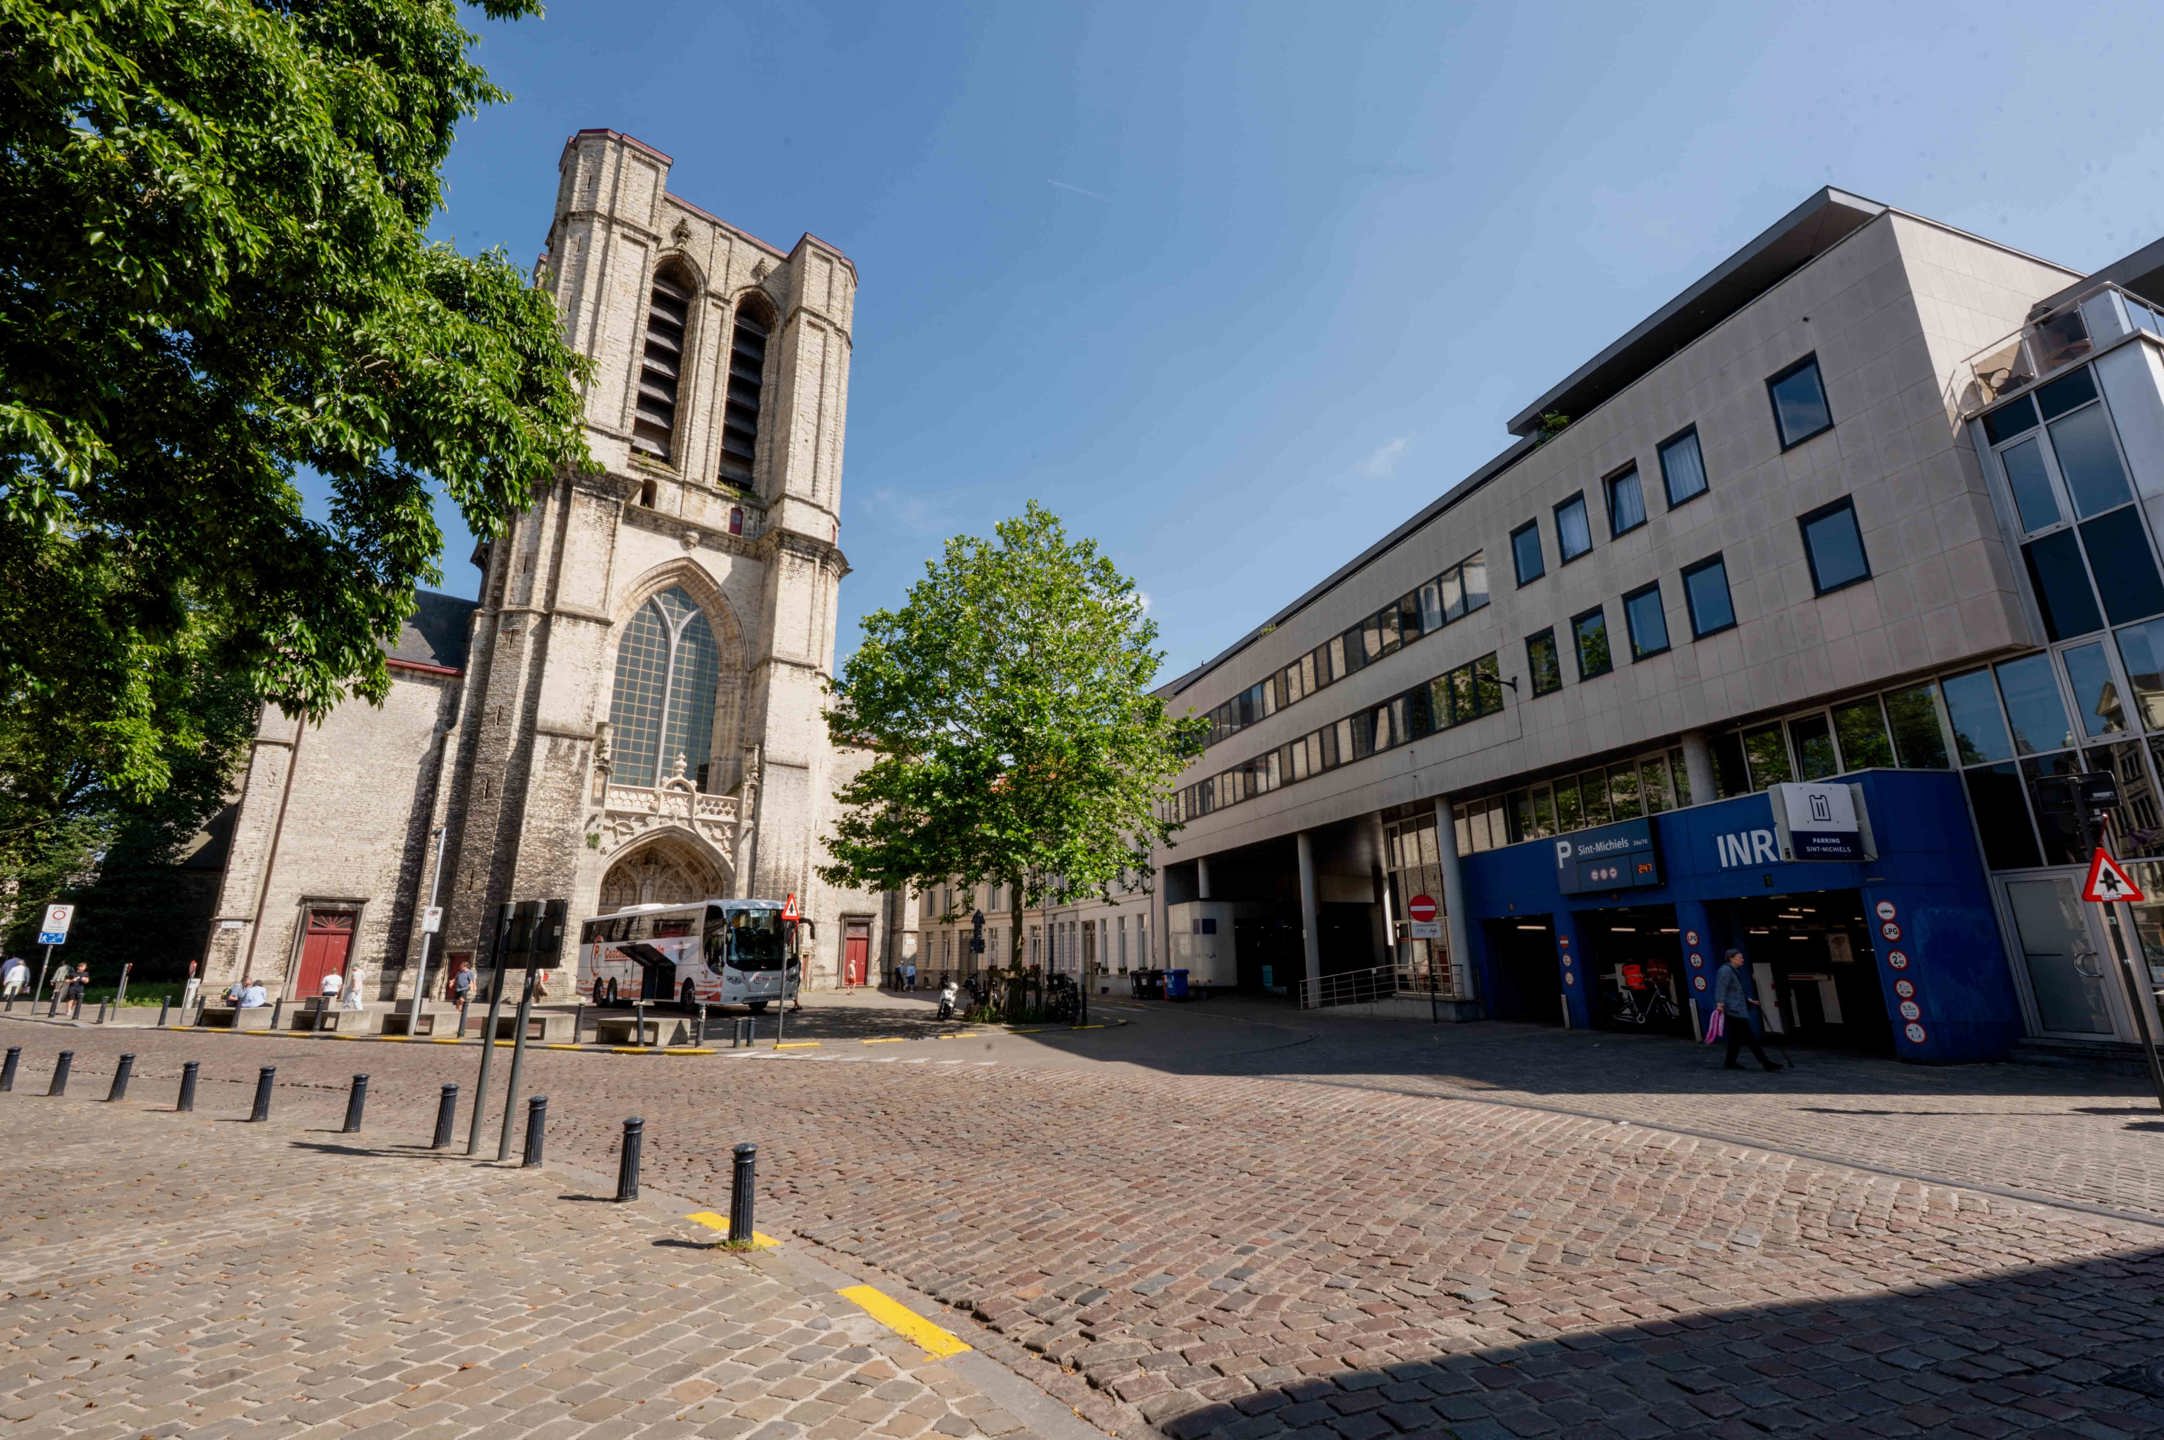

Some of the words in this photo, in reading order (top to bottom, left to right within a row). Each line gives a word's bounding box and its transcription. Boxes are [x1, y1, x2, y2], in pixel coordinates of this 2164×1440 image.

[1812, 837, 1841, 845] PARKING
[1556, 840, 1572, 869] P
[1577, 837, 1630, 856] Sint-Michiels
[1806, 845, 1852, 854] SINT-MICHIELS
[1884, 927, 1898, 935] LPG
